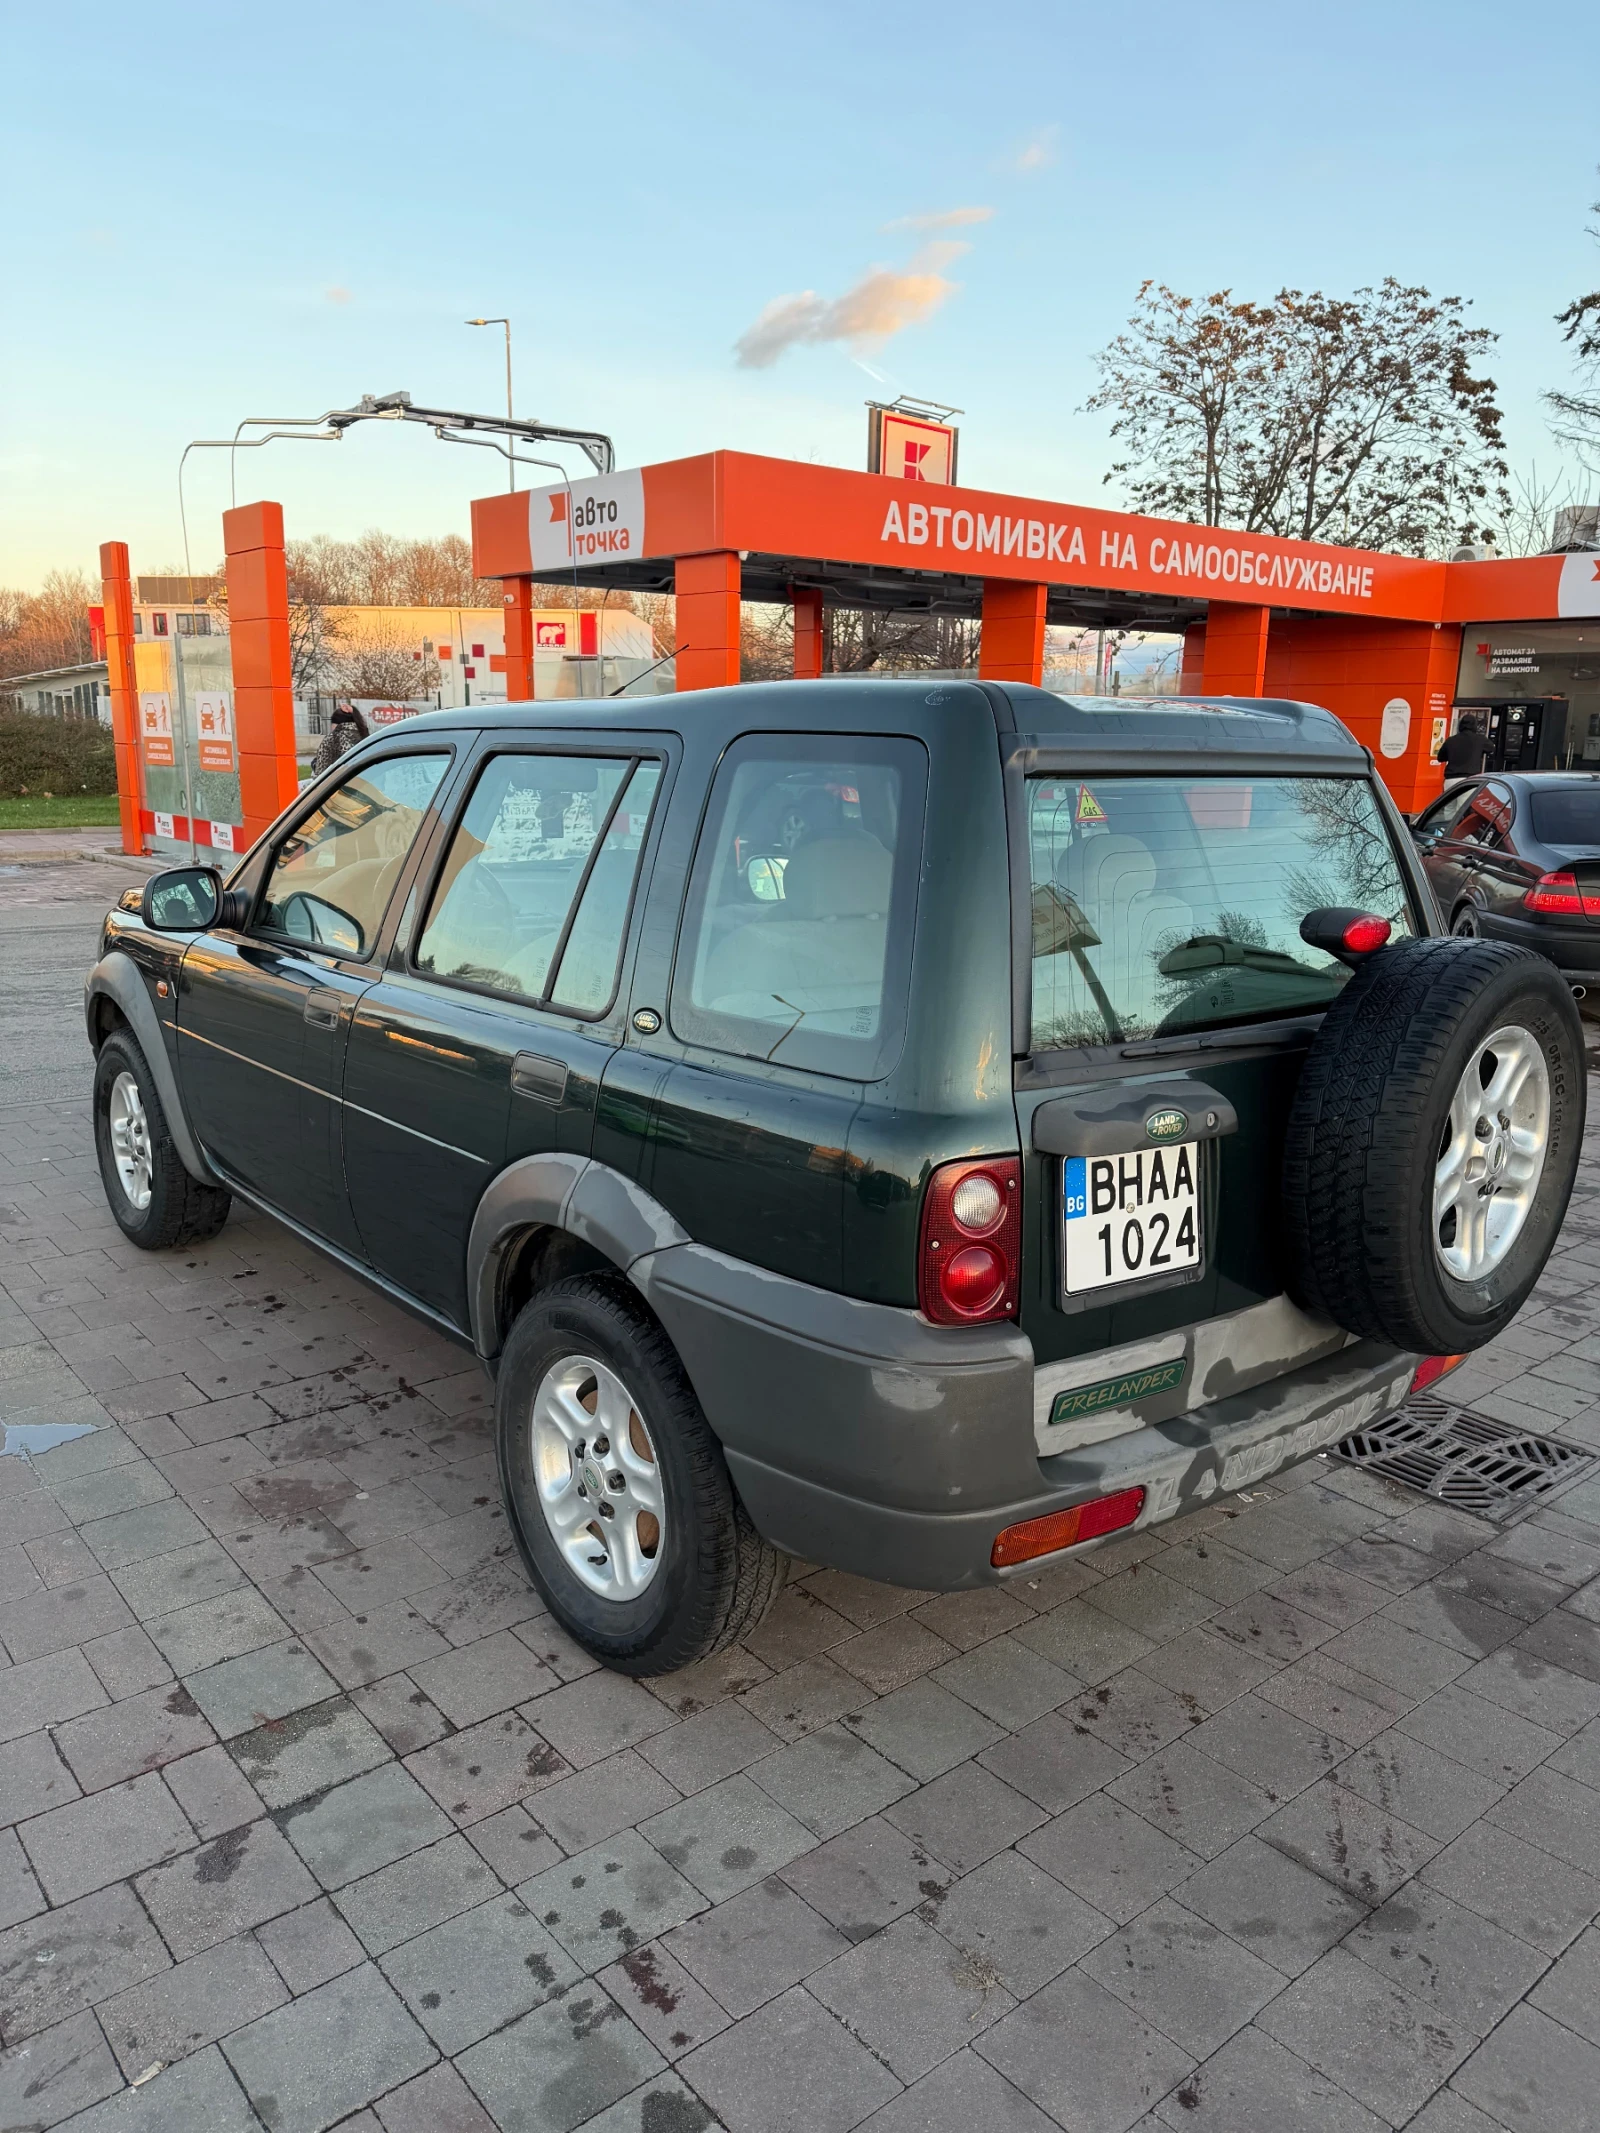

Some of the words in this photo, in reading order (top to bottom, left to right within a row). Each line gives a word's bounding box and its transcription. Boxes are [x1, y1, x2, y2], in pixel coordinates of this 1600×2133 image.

[904, 441, 932, 481] K
[575, 496, 618, 527] авто
[576, 528, 630, 555] точка
[880, 500, 1087, 565] АВТОМИВКА
[1099, 530, 1138, 571] НА
[1149, 538, 1374, 598] САМООБСЛУЖВАНЕ
[1492, 657, 1533, 665] РАЗВАЛЯНЕ
[1493, 648, 1525, 656] АВТОМАТ
[1502, 666, 1540, 674] БАНКНОТИ
[1083, 807, 1098, 816] GAS
[1155, 1115, 1175, 1126] LAND
[1157, 1123, 1182, 1135] ROVER
[1091, 1146, 1194, 1215] BHAA
[1067, 1195, 1085, 1213] BG
[1098, 1205, 1195, 1277] 1024
[1058, 1368, 1176, 1416] FREELANDER
